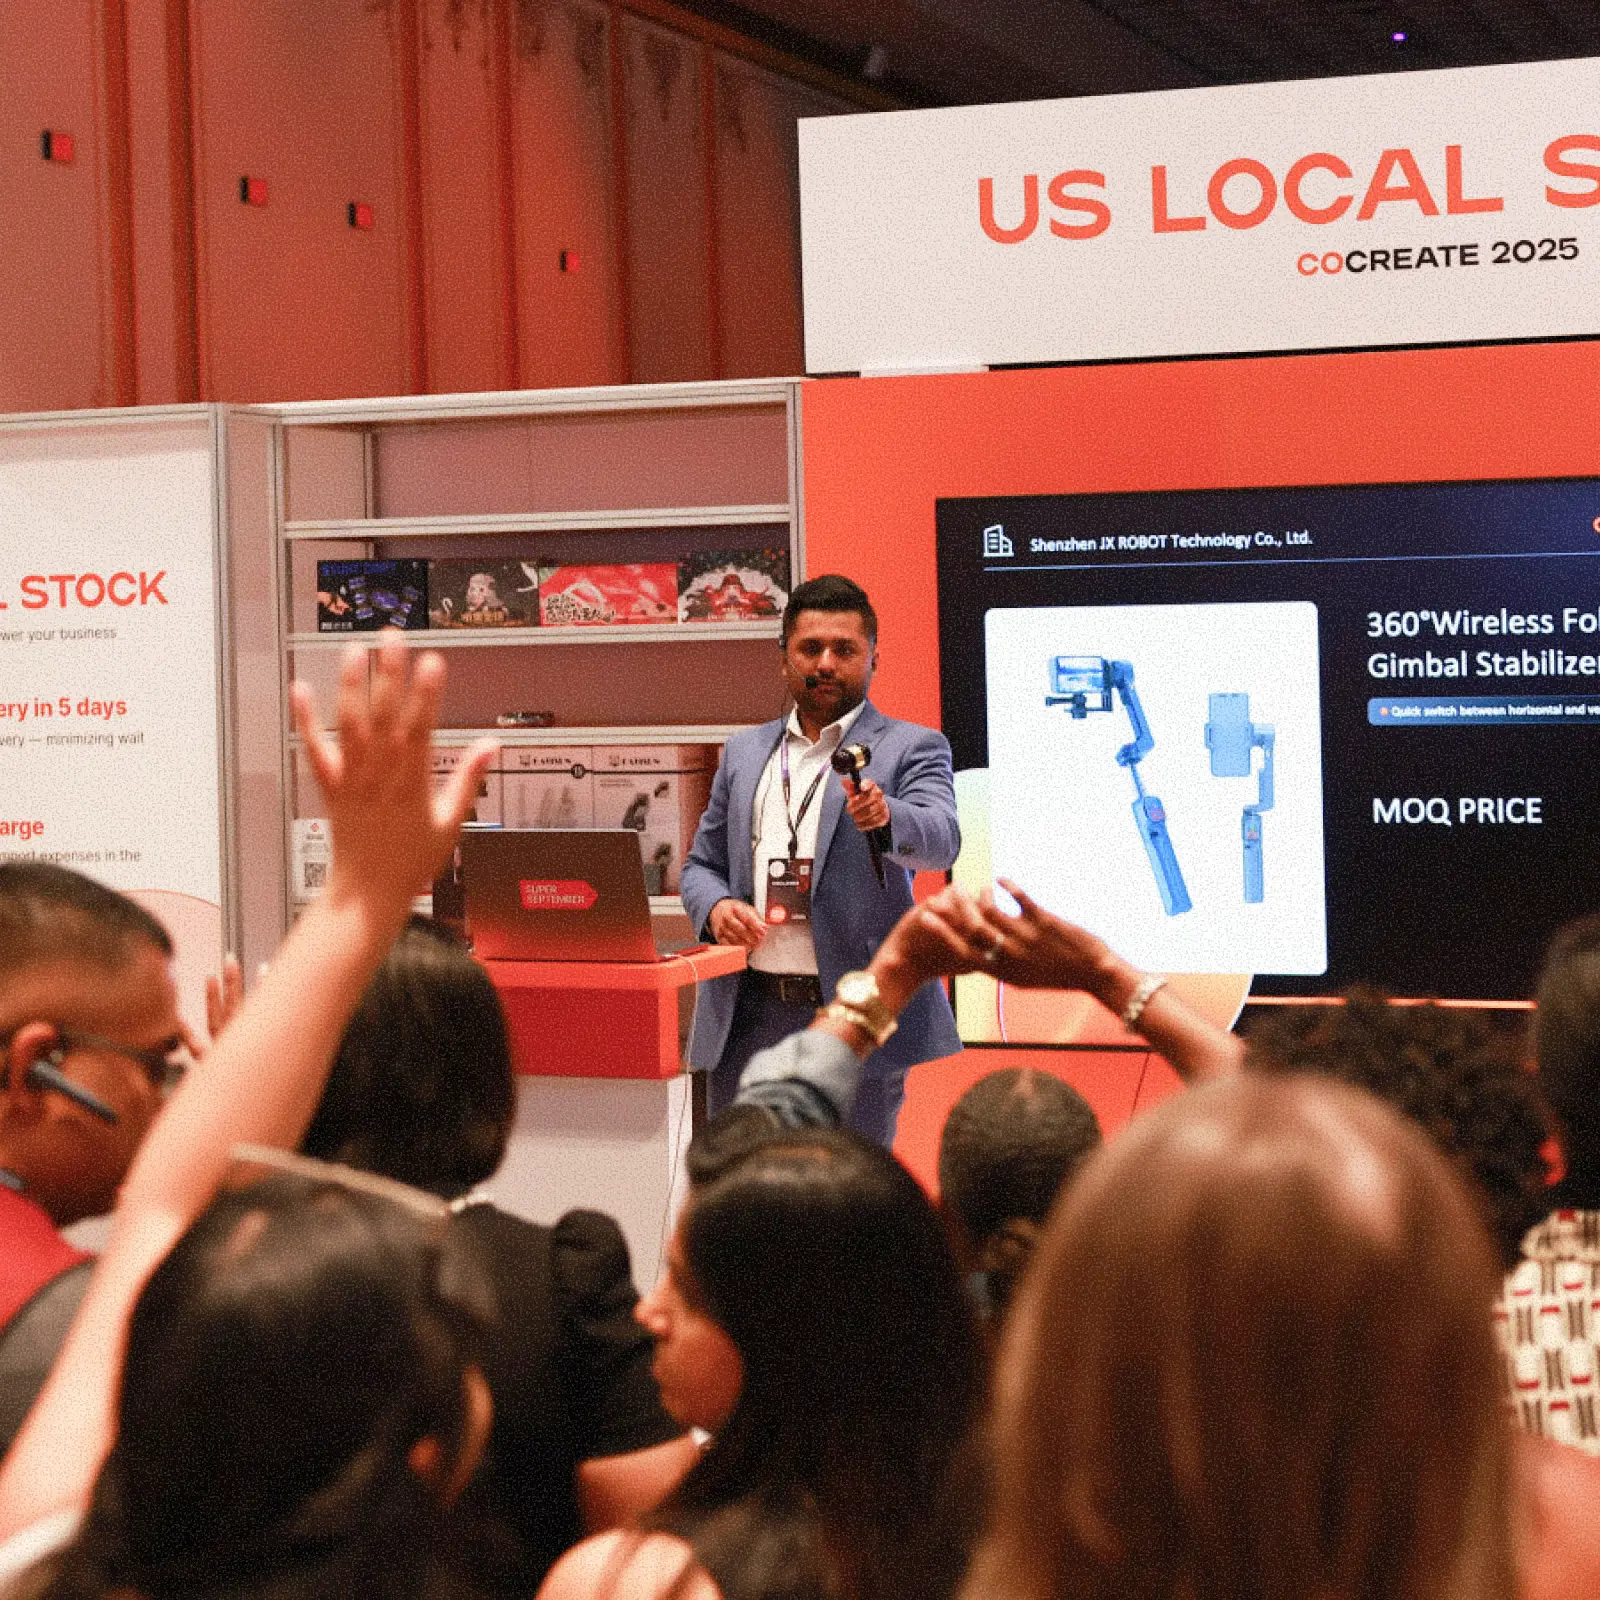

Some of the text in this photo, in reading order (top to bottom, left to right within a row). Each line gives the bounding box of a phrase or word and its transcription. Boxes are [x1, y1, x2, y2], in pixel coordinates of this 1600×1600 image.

[978, 168, 1111, 245] US
[1151, 145, 1504, 234] LOCAL
[1297, 237, 1580, 276] COCREATE 2025
[1030, 530, 1313, 552] Shenzhen JX ROBOT Technology Co., Ltd.
[20, 570, 169, 610] STOCK
[28, 628, 56, 643] your
[60, 628, 117, 641] business
[1367, 650, 1468, 679] Gimbal
[34, 697, 53, 717] in
[58, 697, 72, 717] 5
[76, 697, 127, 720] days
[1391, 705, 1422, 718] Quick
[1424, 704, 1457, 717] switch
[1459, 704, 1507, 717] between
[1507, 703, 1563, 716] horizontal
[1564, 703, 1586, 716] and
[46, 732, 114, 747] minimizing
[117, 732, 144, 744] wait
[1372, 797, 1544, 827] MOQ PRICE
[0, 820, 45, 840] arge
[40, 851, 101, 864] expenses
[105, 849, 116, 862] in
[119, 849, 141, 862] the
